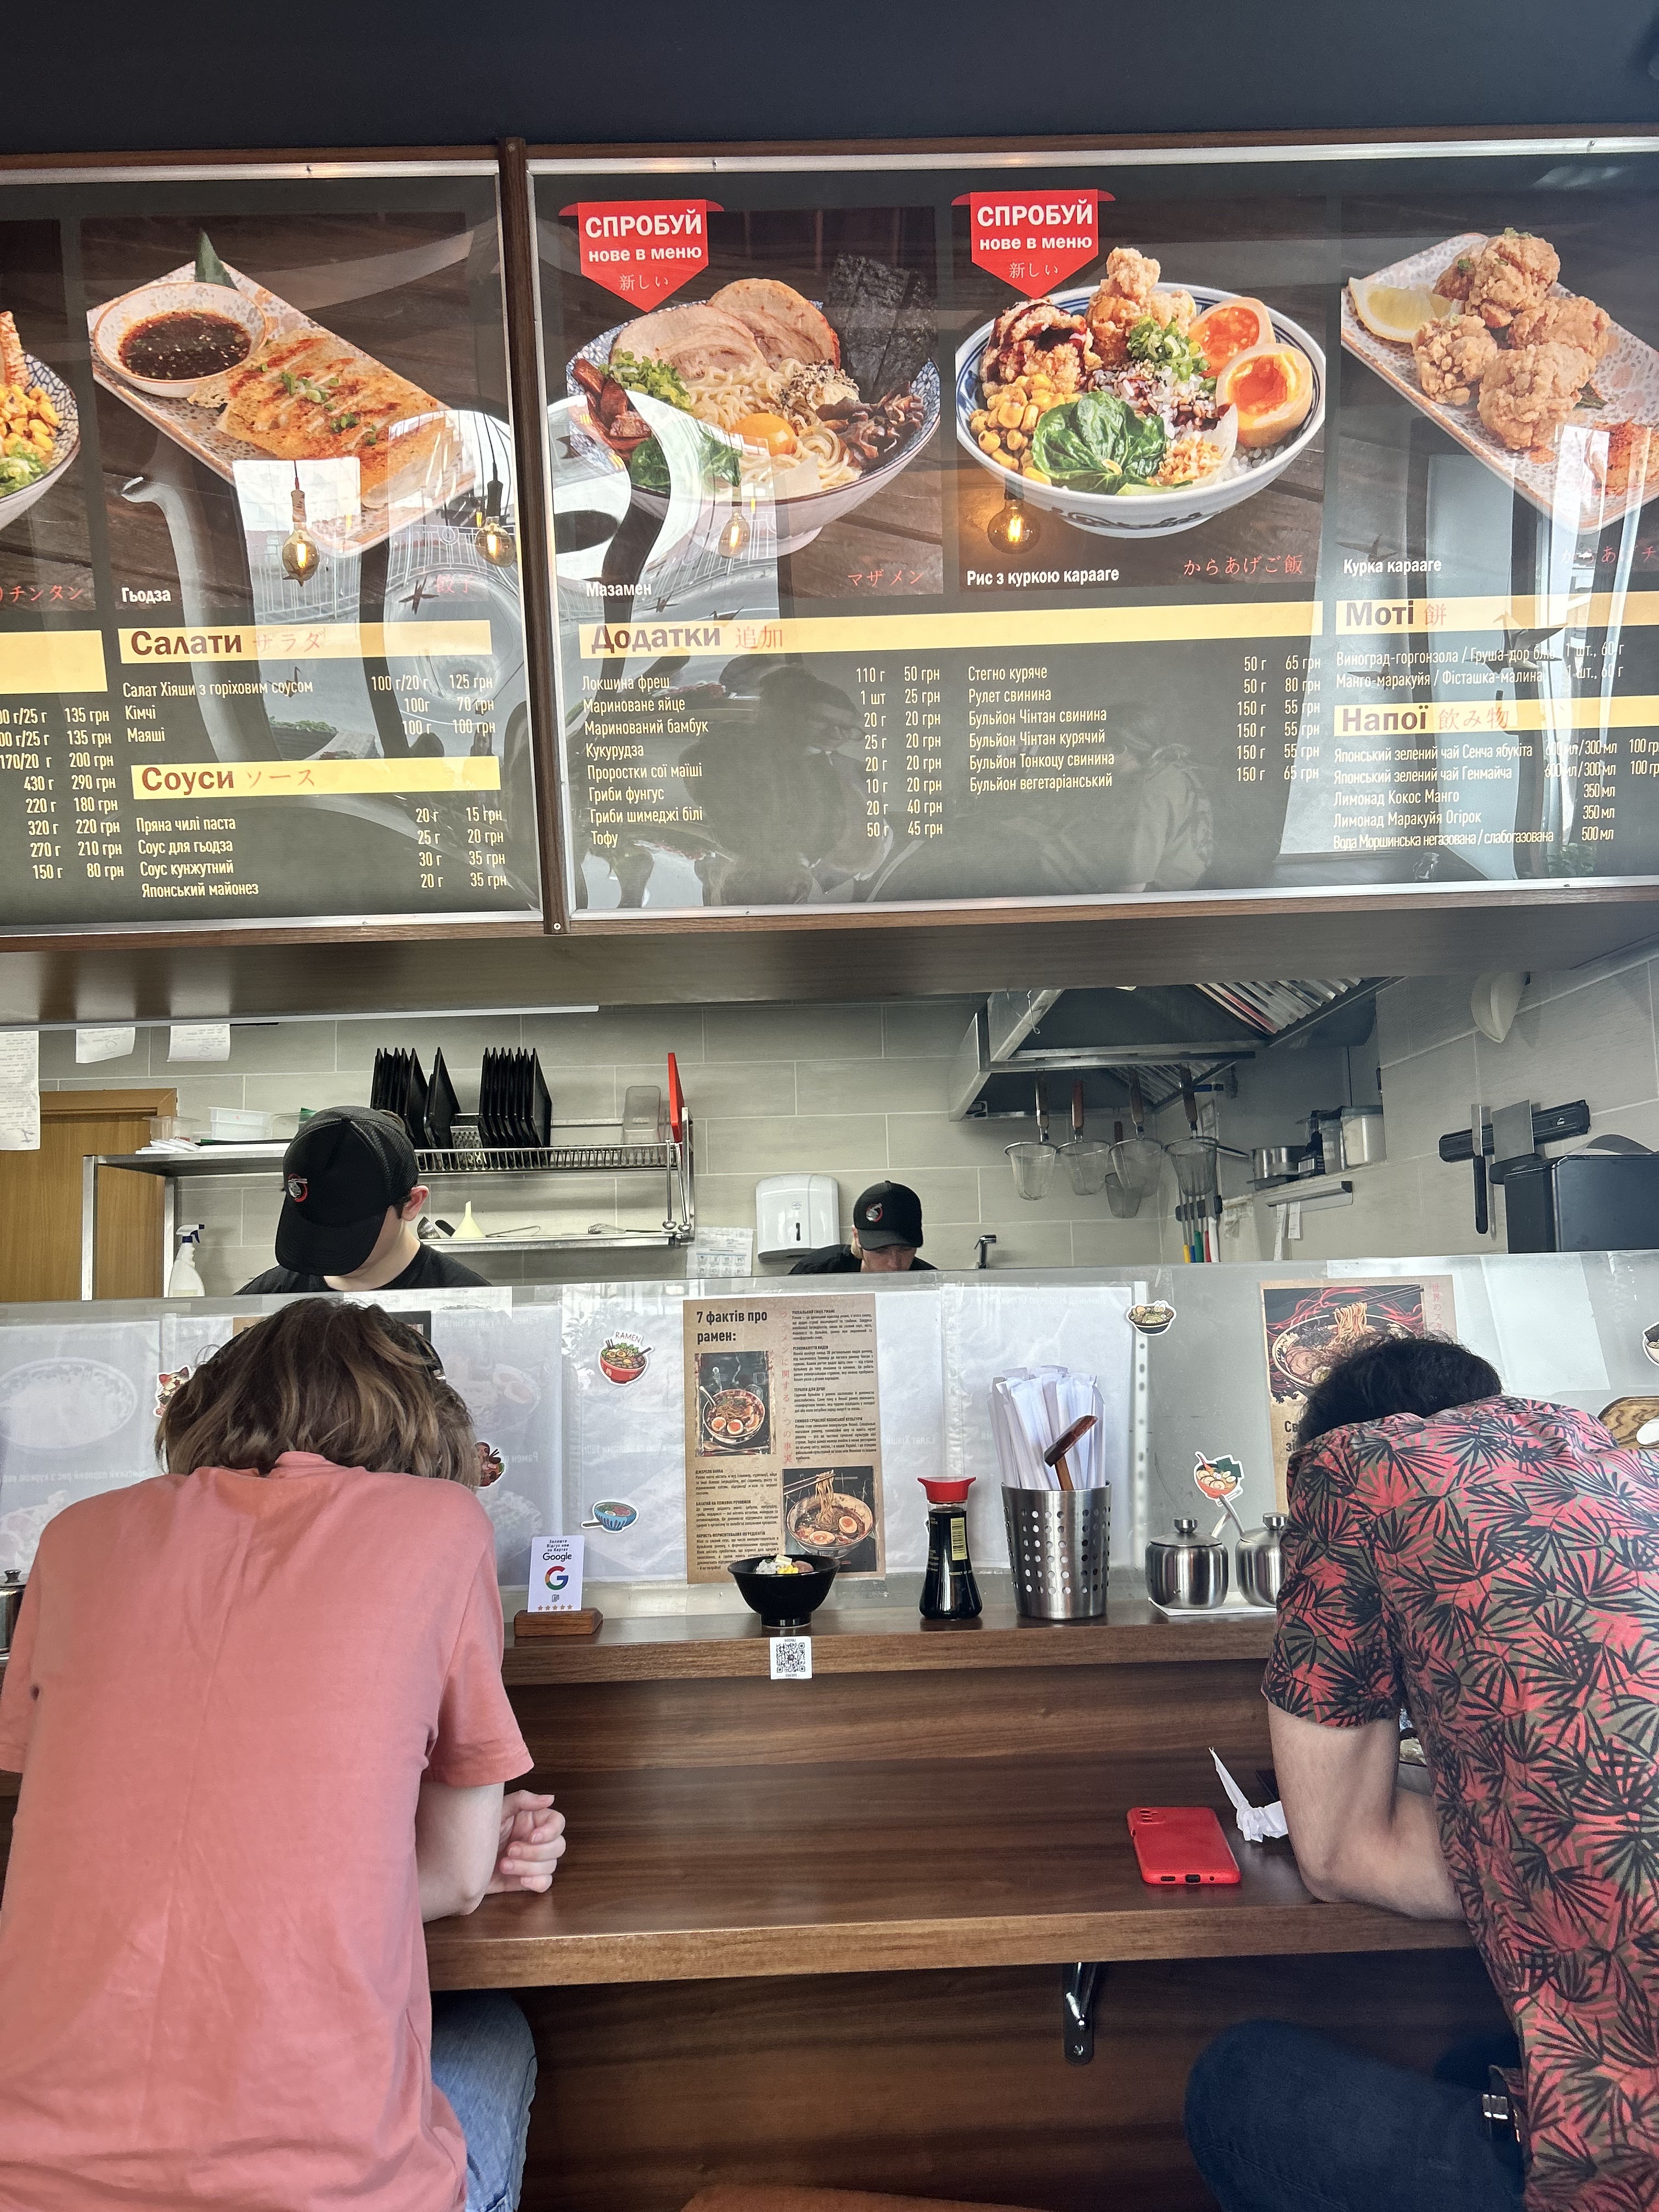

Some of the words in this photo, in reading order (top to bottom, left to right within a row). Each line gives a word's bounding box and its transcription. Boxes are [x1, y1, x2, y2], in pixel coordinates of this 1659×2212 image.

[977, 199, 1092, 227] СПРОБУЙ
[585, 209, 702, 238] СПРОБУЙ
[980, 238, 1021, 250] нове
[1027, 238, 1036, 249] в
[1042, 236, 1092, 249] меню
[589, 250, 630, 262] нове
[636, 249, 646, 261] в
[651, 247, 702, 260] меню
[1009, 262, 1058, 279] 新しい
[619, 274, 669, 291] 新しい
[1183, 554, 1303, 575] からあげご飯
[1344, 559, 1383, 577] Курка
[1387, 560, 1442, 575] карааге
[848, 569, 923, 587] マザメン
[967, 571, 993, 585] Рис
[996, 573, 1004, 584] з
[1008, 570, 1060, 589] куркою
[1064, 568, 1119, 585] карааге
[122, 588, 171, 603] Гьодза
[586, 582, 652, 597] Мазамен
[1346, 600, 1413, 626] Моті
[1424, 603, 1446, 626] 餅
[131, 631, 242, 656] Салати
[252, 631, 323, 652] サラダ
[591, 625, 720, 654] Додатки
[736, 627, 783, 650] 追加
[1337, 651, 1458, 668] Виноград-горгонзола
[968, 667, 1005, 681] Стегно
[1009, 666, 1047, 683] куряче
[1336, 670, 1431, 690] Манго-маракуйя
[1442, 670, 1543, 685] Фісташка-малина
[123, 683, 157, 698] Салат
[160, 683, 196, 697] Хіяши
[199, 685, 206, 696] з
[209, 682, 267, 698] горіховим
[272, 681, 313, 697] соусом
[582, 675, 634, 691] Локшина
[638, 675, 670, 695] фреш
[583, 698, 654, 714] Мариноване
[658, 697, 685, 713] яйце
[968, 689, 1000, 706] Рулет
[1004, 689, 1051, 703] свинина
[64, 708, 86, 723] 135
[89, 710, 109, 725] грн
[125, 706, 156, 721] Кімчі
[969, 710, 1015, 729] Бульйон
[1019, 709, 1056, 724] Чінтан
[1059, 708, 1107, 723] свинина
[1342, 705, 1429, 732] Напої
[1438, 707, 1509, 730] 飲み物
[127, 727, 165, 743] Маяші
[585, 720, 663, 736] Маринований
[668, 718, 709, 736] бамбук
[66, 730, 88, 745] 135
[92, 732, 111, 748] грн
[969, 732, 1015, 751] Бульйон
[1020, 731, 1056, 746] Чінтан
[1059, 729, 1105, 747] курячий
[586, 743, 644, 760] Кукурудза
[1334, 748, 1391, 763] Японський
[1395, 746, 1438, 760] зелений
[1441, 745, 1459, 758] чай
[1462, 744, 1493, 758] Сенча
[1496, 743, 1532, 760] ябукіта
[69, 752, 91, 768] 200
[94, 754, 114, 770] грн
[969, 754, 1015, 773] Бульйон
[1020, 753, 1064, 770] Тонкоцу
[1067, 752, 1114, 766] свинина
[588, 765, 647, 781] Проростки
[651, 764, 667, 778] сої
[670, 762, 702, 777] маїші
[1334, 769, 1391, 785] Японський
[1394, 768, 1437, 782] зелений
[1441, 766, 1458, 780] чай
[1462, 765, 1511, 780] Генмайча
[71, 775, 93, 790] 290
[96, 777, 116, 792] грн
[142, 767, 234, 795] Соуси
[247, 769, 315, 789] ソース
[970, 776, 1016, 795] Бульйон
[1020, 772, 1112, 792] вегетаріанський
[589, 787, 622, 803] Гриби
[625, 788, 664, 804] фунгус
[1333, 792, 1384, 806] Лимонад
[1389, 790, 1421, 804] Кокос
[1425, 789, 1459, 803] Манго
[1584, 783, 1600, 798] 350
[1601, 786, 1615, 797] мл
[74, 797, 95, 812] 180
[98, 799, 118, 814] грн
[1583, 805, 1599, 819] 350
[1601, 808, 1615, 819] мл
[466, 808, 480, 821] 15
[483, 808, 502, 824] грн
[590, 809, 623, 825] Гриби
[627, 807, 679, 824] шимеджі
[682, 806, 703, 821] білі
[1333, 813, 1384, 828] Лимонад
[1388, 811, 1442, 828] Маракуйя
[1446, 810, 1482, 826] Огірок
[76, 819, 97, 834] 220
[100, 821, 120, 837] грн
[136, 817, 172, 834] Пряна
[174, 816, 201, 831] чилі
[203, 817, 236, 830] паста
[1582, 826, 1598, 841] 500
[1600, 829, 1614, 840] мл
[467, 830, 481, 844] 20
[484, 831, 504, 845] грн
[591, 831, 618, 848] Тофу
[1333, 835, 1356, 850] Вода
[1359, 833, 1421, 851] Моршинська
[1424, 833, 1476, 847] негазована
[1484, 829, 1554, 844] слабогазована
[78, 841, 99, 856] 210
[102, 843, 122, 859] грн
[138, 839, 165, 855] Соус
[168, 841, 190, 855] для
[193, 840, 233, 854] гьодза
[469, 851, 483, 865] 35
[486, 853, 505, 868] грн
[87, 863, 101, 878] 80
[104, 865, 124, 881] грн
[140, 861, 168, 877] Соус
[170, 860, 234, 876] кунжутний
[470, 873, 483, 888] 35
[487, 874, 507, 889] грн
[142, 882, 206, 899] Японський
[208, 882, 259, 896] майонез
[697, 1311, 703, 1323] 7
[706, 1310, 744, 1325] фактів
[748, 1311, 768, 1325] про
[616, 1331, 641, 1343] RAMEN
[697, 1331, 736, 1345] рамен:
[543, 1552, 572, 1562] Google
